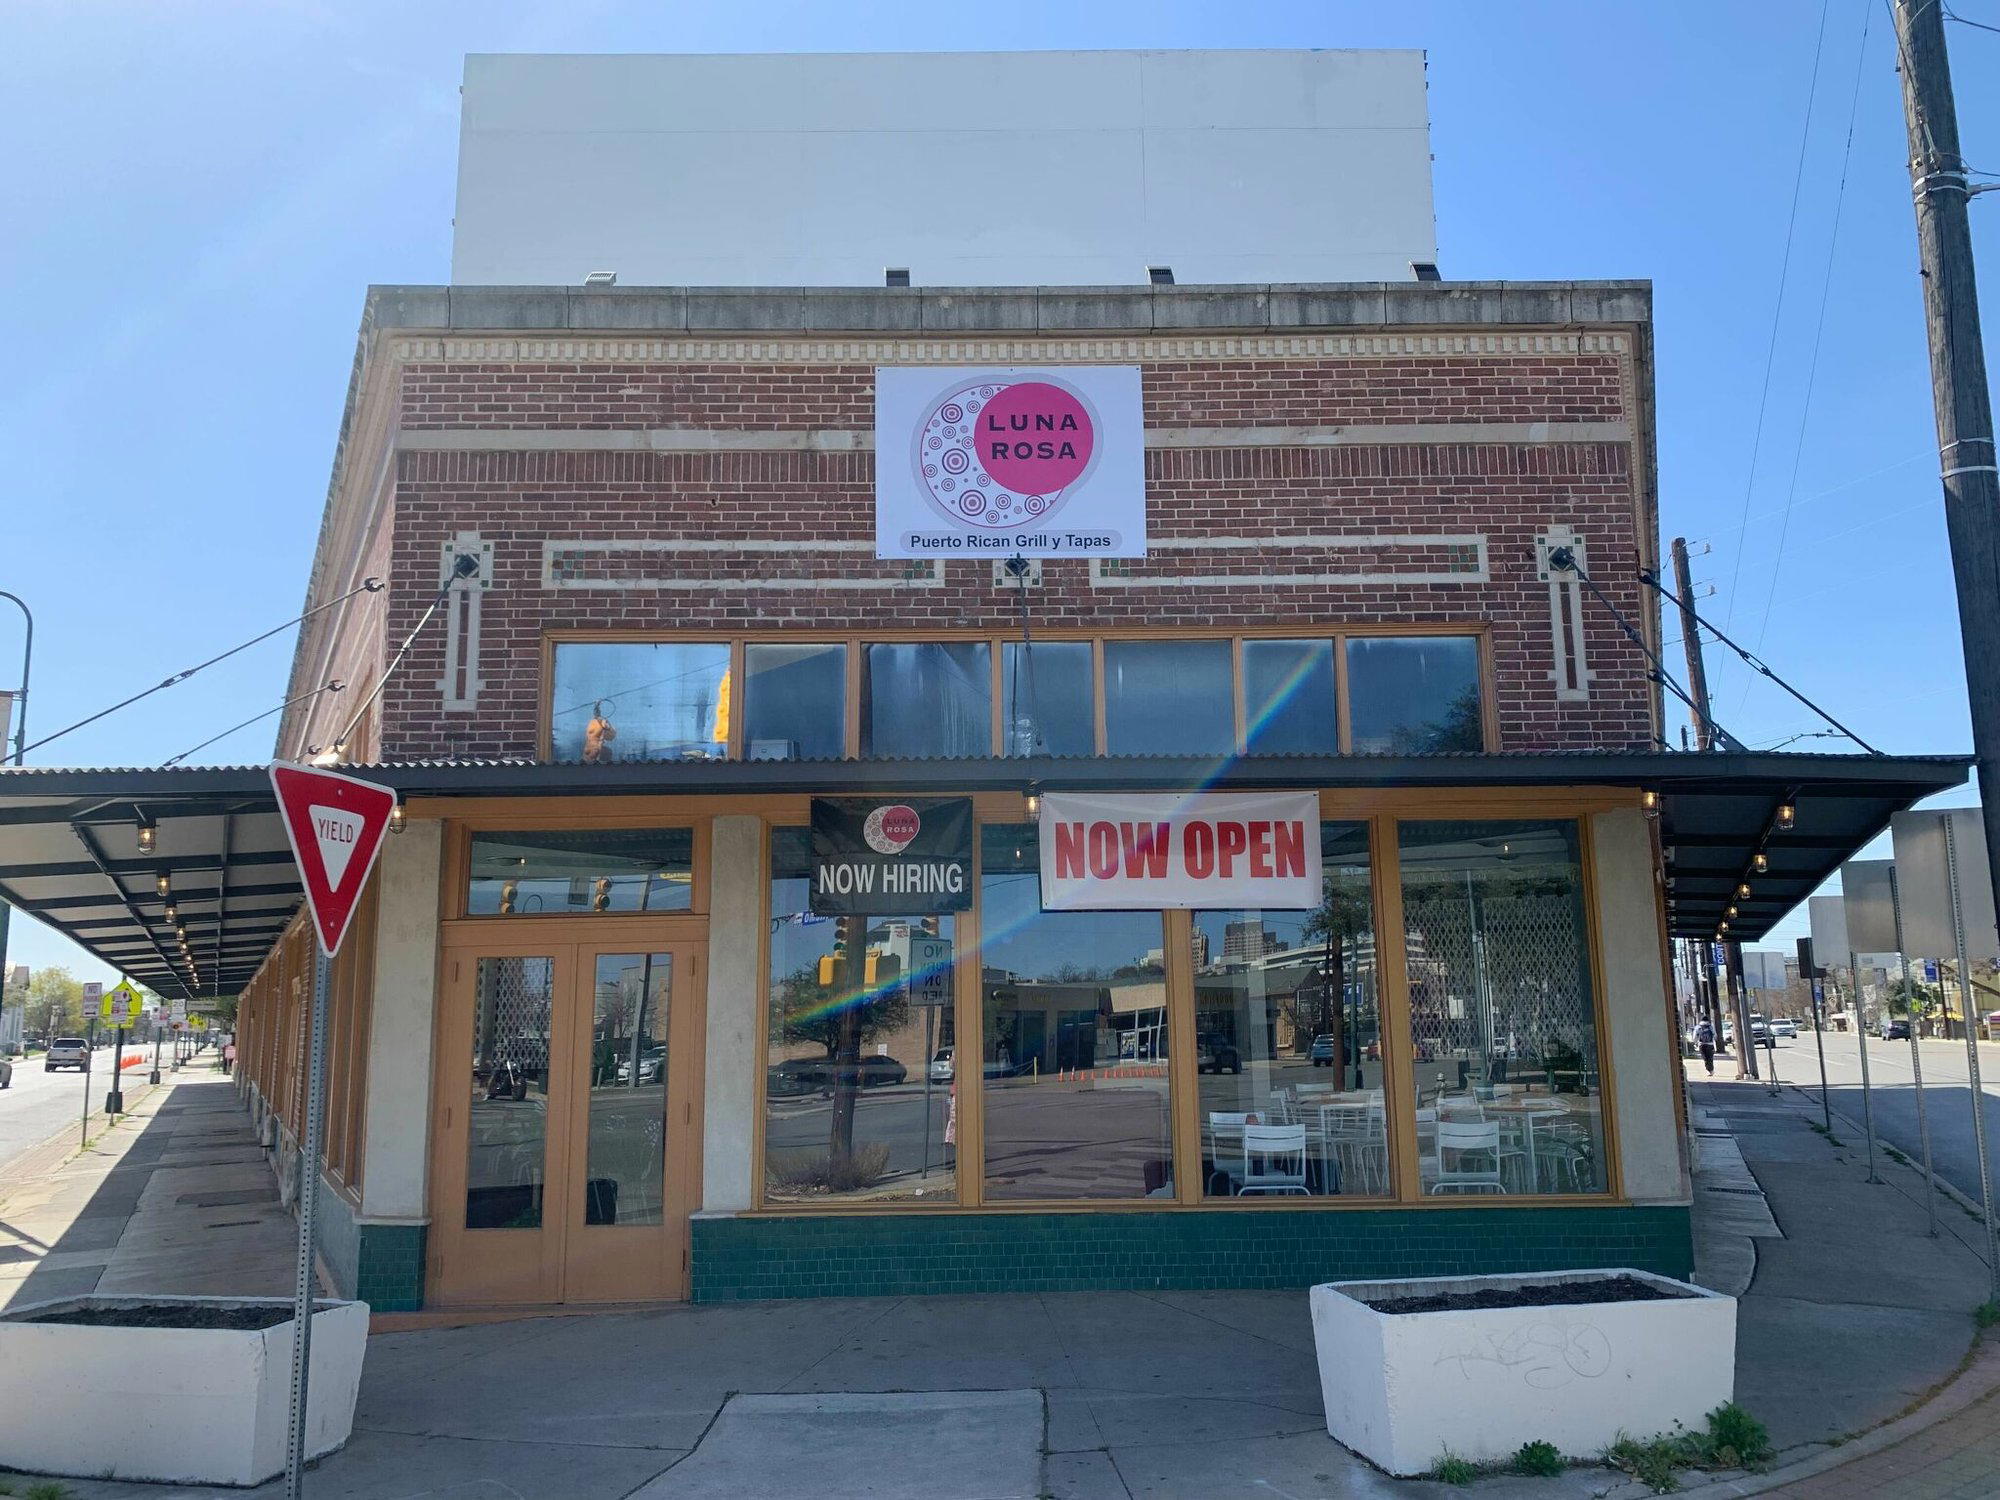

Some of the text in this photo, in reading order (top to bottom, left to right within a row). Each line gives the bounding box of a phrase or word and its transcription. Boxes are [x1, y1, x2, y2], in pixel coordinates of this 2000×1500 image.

[988, 414, 1079, 432] LUNA
[991, 441, 1077, 460] ROSA
[910, 534, 1111, 550] Puerto Rican Grill y Tapas
[318, 818, 354, 844] YIELD
[1055, 820, 1306, 880] NOW OPEN
[819, 863, 963, 895] NOW HIRING
